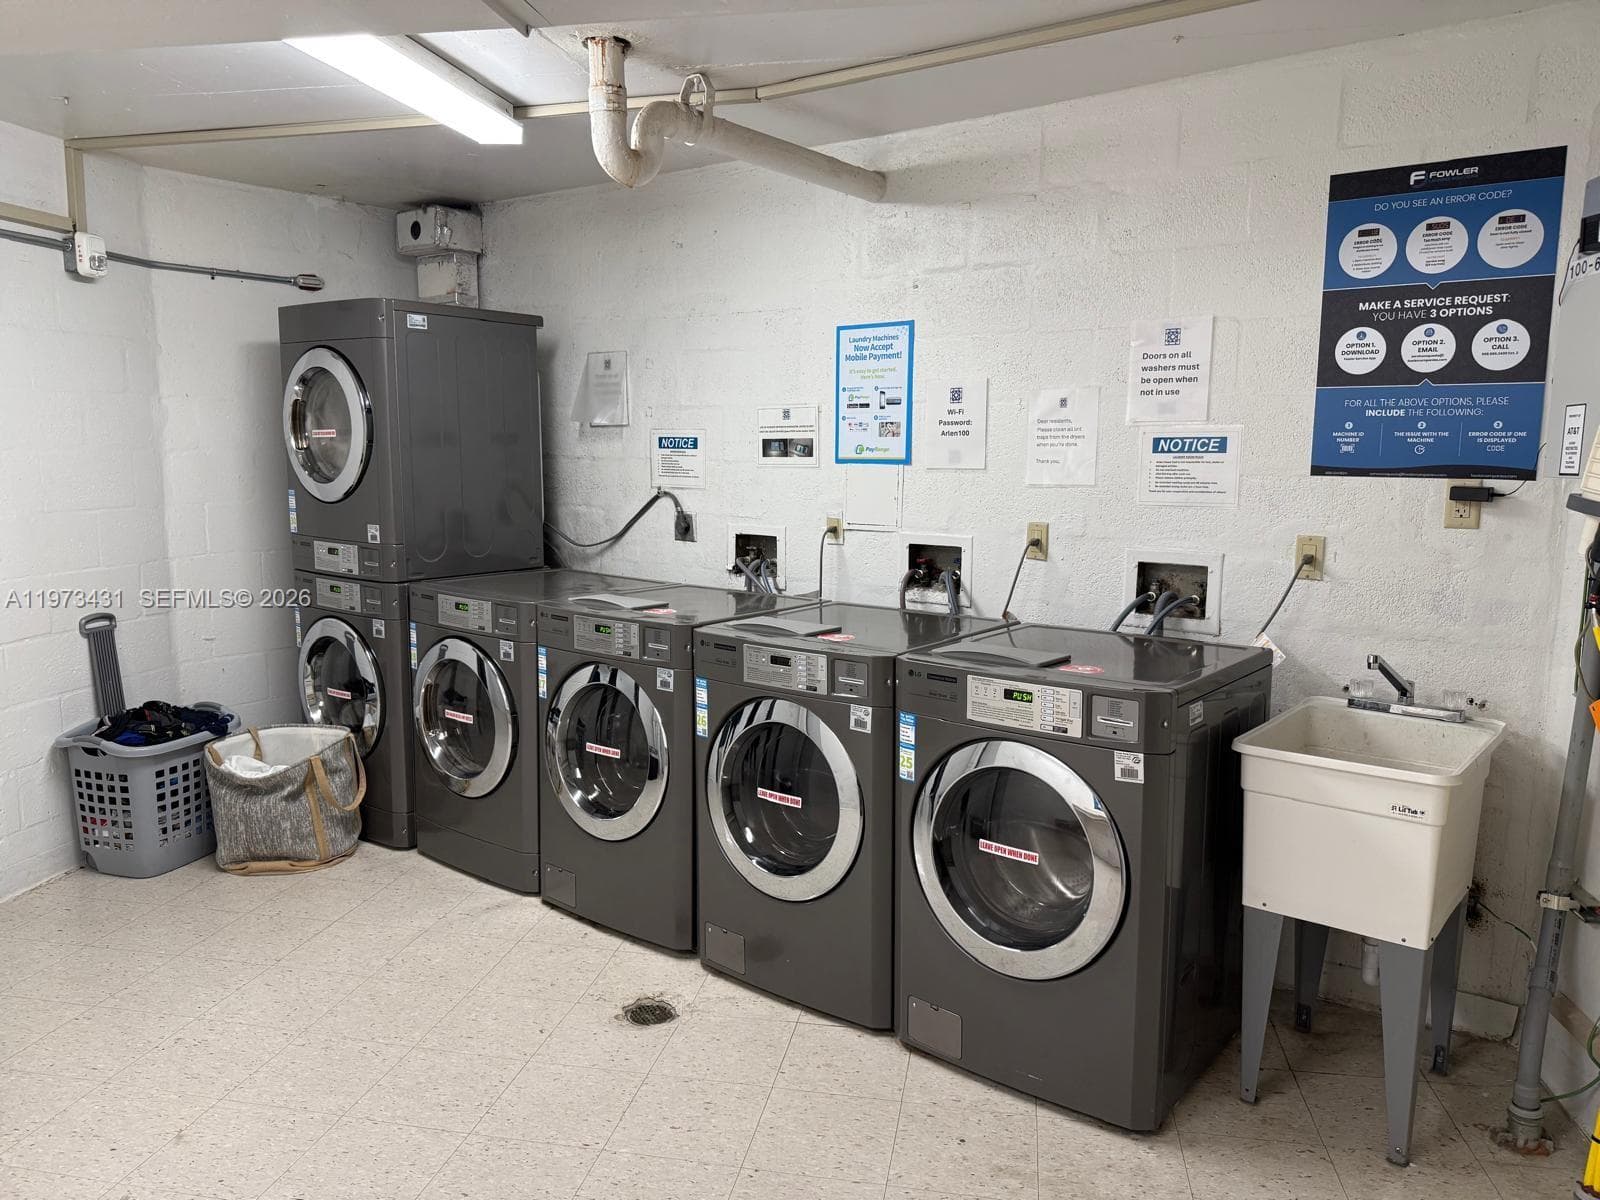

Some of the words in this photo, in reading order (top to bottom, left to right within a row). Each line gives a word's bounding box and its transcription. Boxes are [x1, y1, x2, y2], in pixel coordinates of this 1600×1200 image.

[1430, 166, 1479, 179] FOWLER
[1374, 203, 1389, 212] DO
[1391, 201, 1410, 210] YOU
[1412, 199, 1427, 208] SEE
[1429, 197, 1444, 206] AN
[1445, 193, 1476, 204] ERROR
[1478, 189, 1513, 200] CODE?
[1359, 301, 1391, 311] MAKE
[1393, 300, 1402, 309] A
[1404, 297, 1452, 308] SERVICE
[1454, 293, 1511, 305] REQUEST:
[1372, 312, 1396, 322] YOU
[1398, 310, 1428, 320] HAVE
[1430, 310, 1437, 318] 3
[1439, 306, 1494, 317] OPTIONS
[872, 334, 899, 342] Machines
[853, 344, 870, 352] Now
[870, 343, 893, 351] Accept
[845, 353, 868, 361] Mobile
[868, 351, 902, 361] Payment!
[1142, 352, 1167, 360] Doors
[1141, 364, 1176, 372] washers
[1178, 363, 1200, 371] must
[1153, 377, 1174, 385] open
[1344, 399, 1362, 408] FOR
[1364, 399, 1377, 407] ALL
[1380, 398, 1396, 407] THE
[1398, 398, 1429, 407] ABOVE
[1431, 397, 1474, 407] OPTIONS,
[1477, 397, 1509, 406] PLEASE
[1365, 409, 1406, 417] INCLUDE
[1408, 408, 1424, 417] THE
[1426, 408, 1484, 417] FOLLOWING:
[1567, 427, 1580, 435] AT&T
[661, 438, 695, 448] NOTICE
[1158, 439, 1221, 452] NOTICE
[1013, 692, 1032, 702] PUSH
[900, 755, 913, 769] 25
[980, 840, 993, 851] LEAVE
[994, 845, 1007, 854] OPEN
[1007, 848, 1023, 859] WHEN
[1023, 852, 1038, 863] DONE
